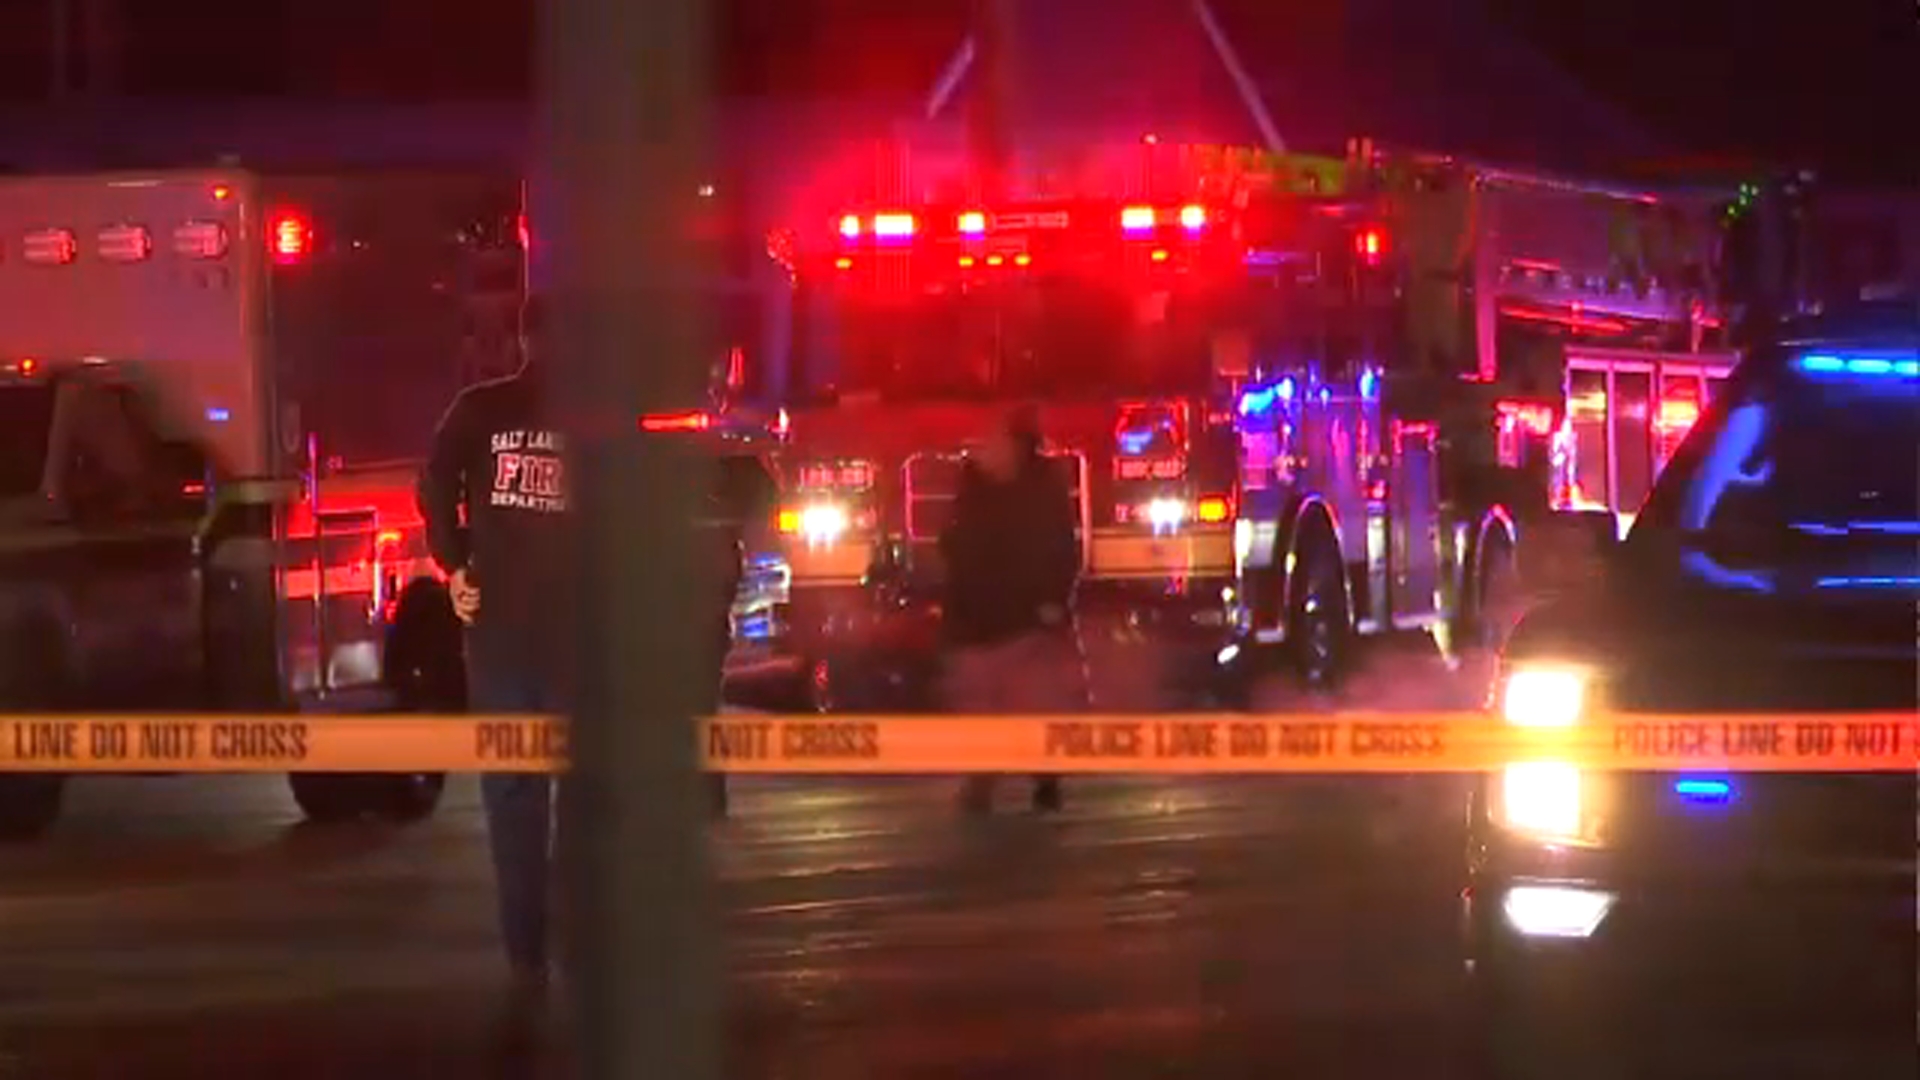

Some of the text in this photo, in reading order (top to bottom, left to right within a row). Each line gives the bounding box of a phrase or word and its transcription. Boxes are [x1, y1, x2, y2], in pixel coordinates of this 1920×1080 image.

[491, 430, 525, 453] SALT
[495, 452, 563, 495] FIR
[14, 722, 308, 759] LINE DO NOT CROSS
[475, 721, 569, 760] POLIC
[709, 721, 879, 759] NOT CROSS
[1045, 722, 1445, 758] POLICE LINE DO NOT CROSS
[1613, 721, 1904, 756] POLICE LINE DO NOT
